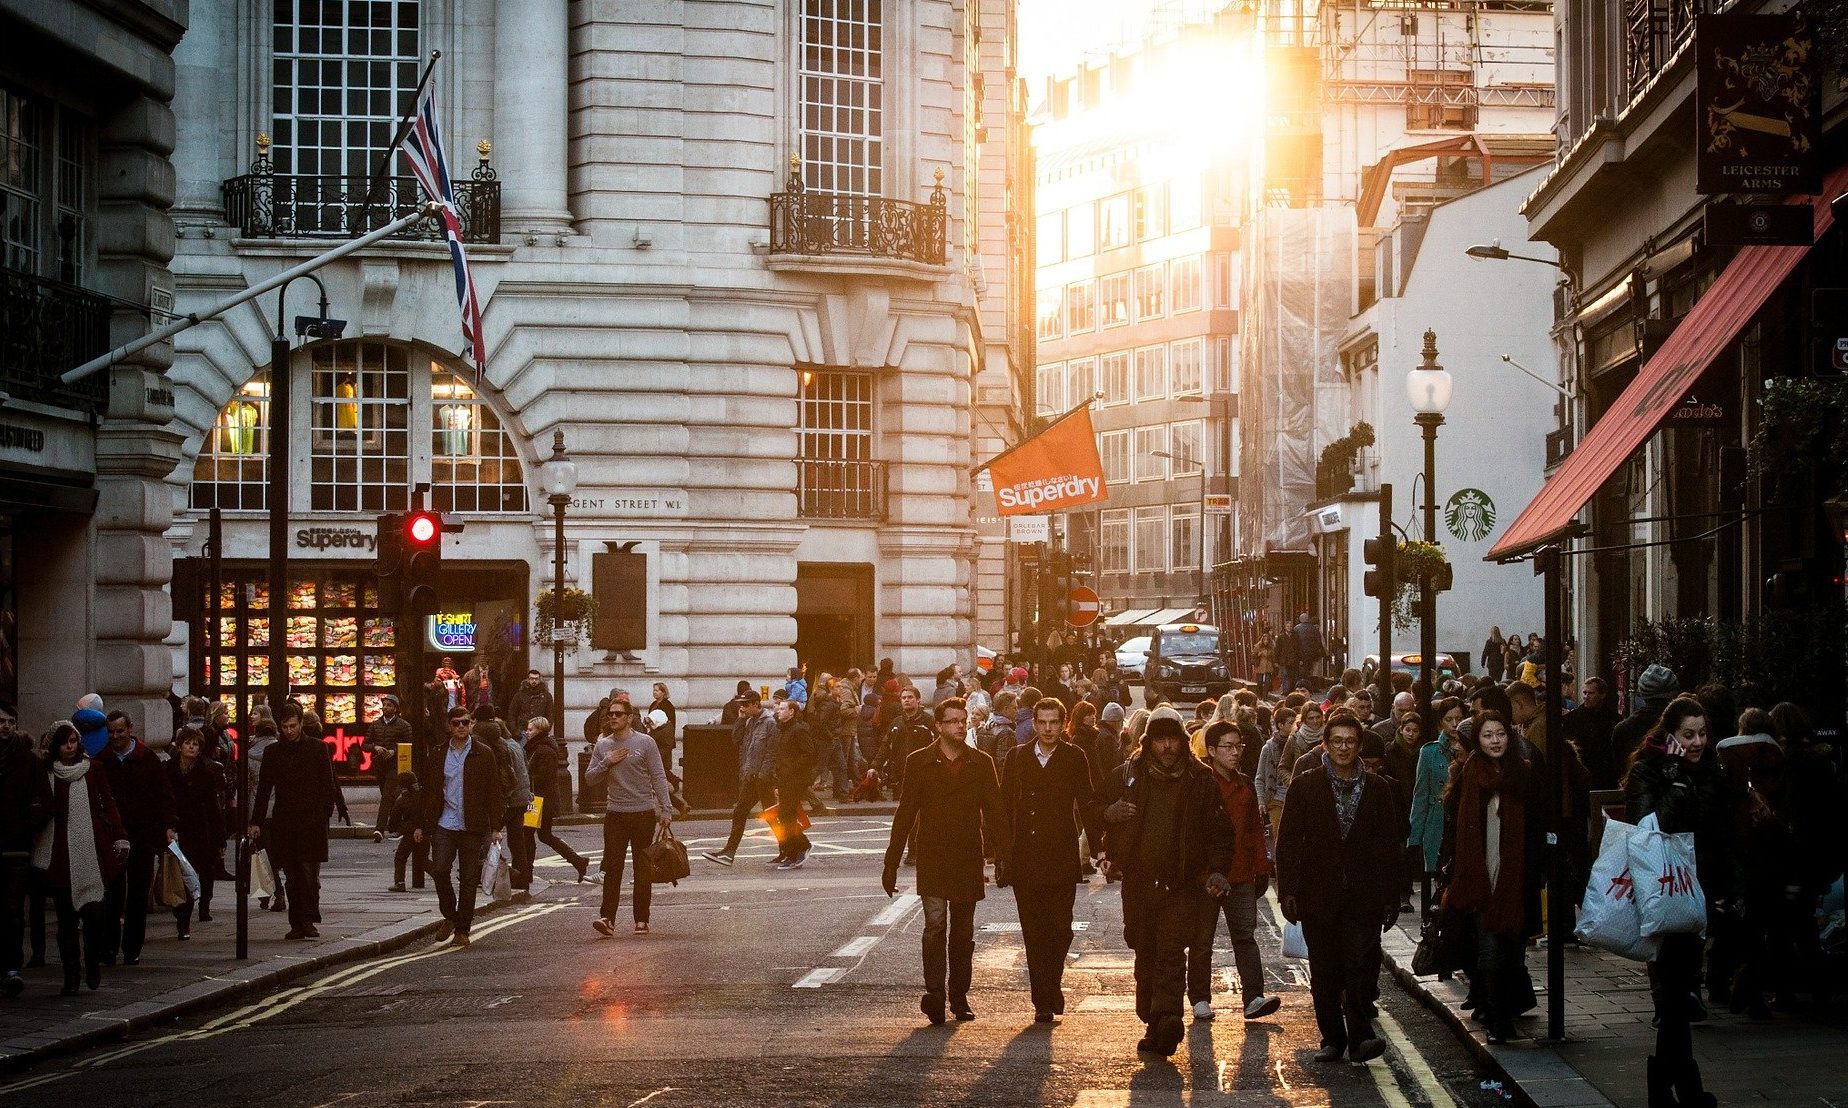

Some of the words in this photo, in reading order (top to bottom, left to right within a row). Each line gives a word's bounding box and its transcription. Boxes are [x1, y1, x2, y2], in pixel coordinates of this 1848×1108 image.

[1722, 165, 1799, 176] LEICESTER
[1742, 179, 1782, 189] ARMS
[998, 474, 1100, 509] Superdry
[567, 499, 605, 509] GENT
[615, 499, 658, 509] STREET
[296, 529, 378, 552] Superdry
[443, 634, 473, 645] OPEN
[1657, 862, 1696, 899] H&M
